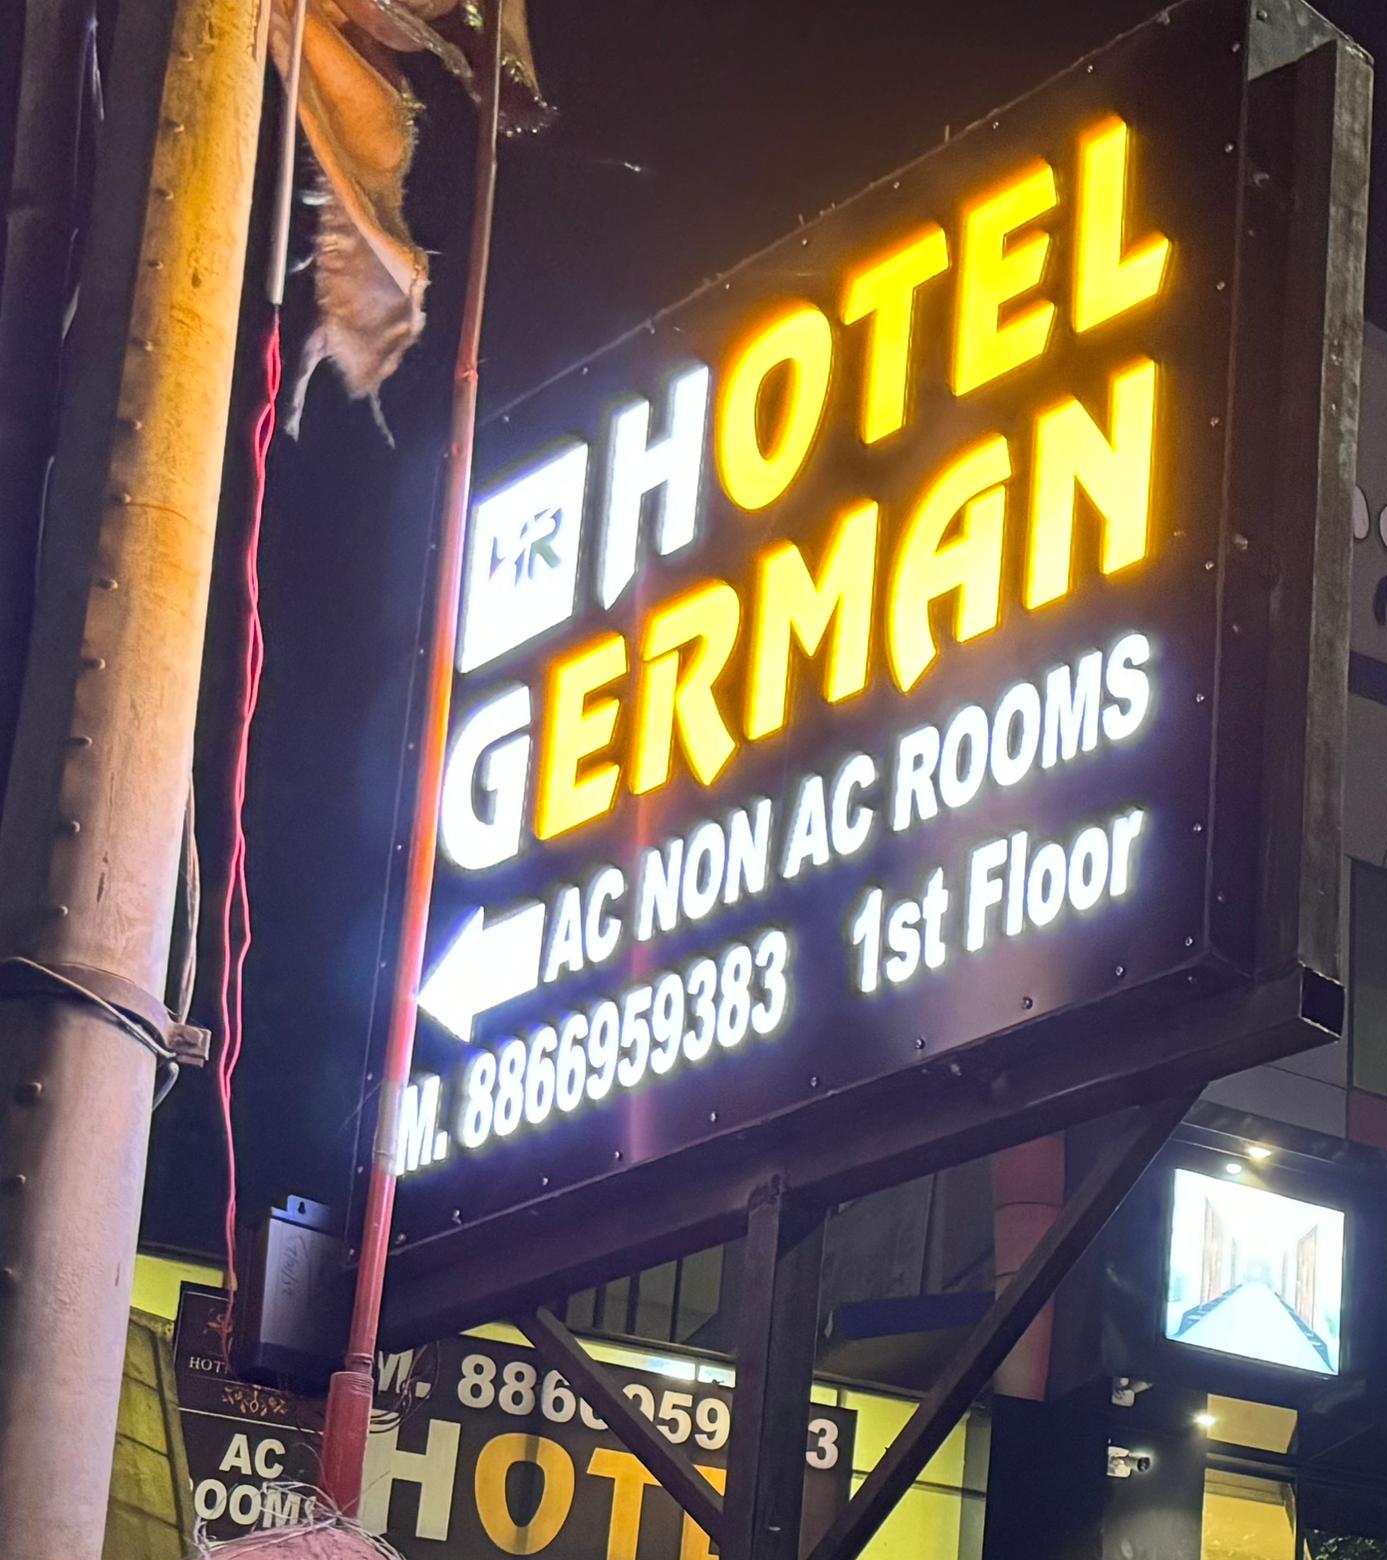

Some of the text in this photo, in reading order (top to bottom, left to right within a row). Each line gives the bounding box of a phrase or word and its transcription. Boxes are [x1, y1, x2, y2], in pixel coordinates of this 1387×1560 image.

[604, 114, 1171, 609] HOTEL
[438, 357, 1159, 870] GERMAN
[539, 632, 1152, 984] AC NON AC ROOMS
[850, 808, 1146, 995] 1st Floor
[460, 929, 790, 1151] 8866959383
[218, 1433, 286, 1479] AC
